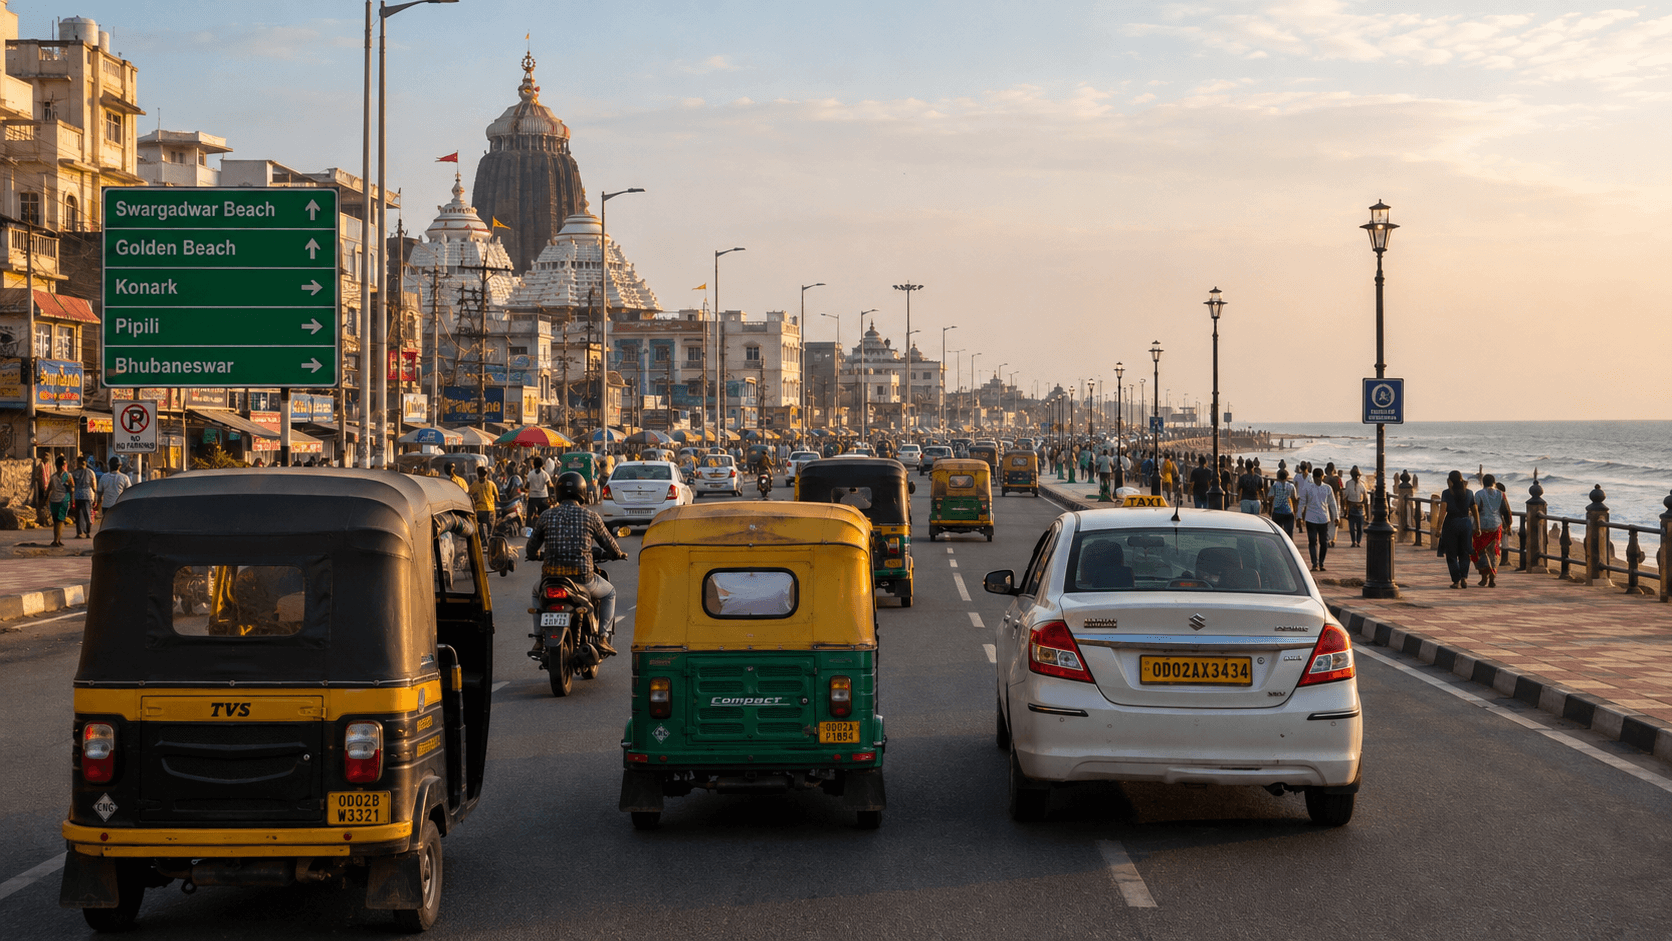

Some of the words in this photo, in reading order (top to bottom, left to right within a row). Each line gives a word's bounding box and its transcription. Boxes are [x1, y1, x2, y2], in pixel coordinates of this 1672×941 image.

[115, 200, 218, 220] Swargadwar
[223, 201, 275, 217] Beach
[115, 239, 177, 256] Golden
[183, 239, 236, 256] Beach
[115, 278, 178, 295] Konark
[115, 318, 160, 338] Pipili
[115, 357, 234, 374] Bhubaneswar
[1128, 497, 1161, 507] TAXI
[1152, 661, 1249, 679] OD02AX3434
[711, 696, 783, 706] Compact
[210, 702, 252, 718] TVS
[97, 802, 114, 813] CNG
[338, 794, 380, 807] OD02B
[337, 808, 380, 823] W3321
